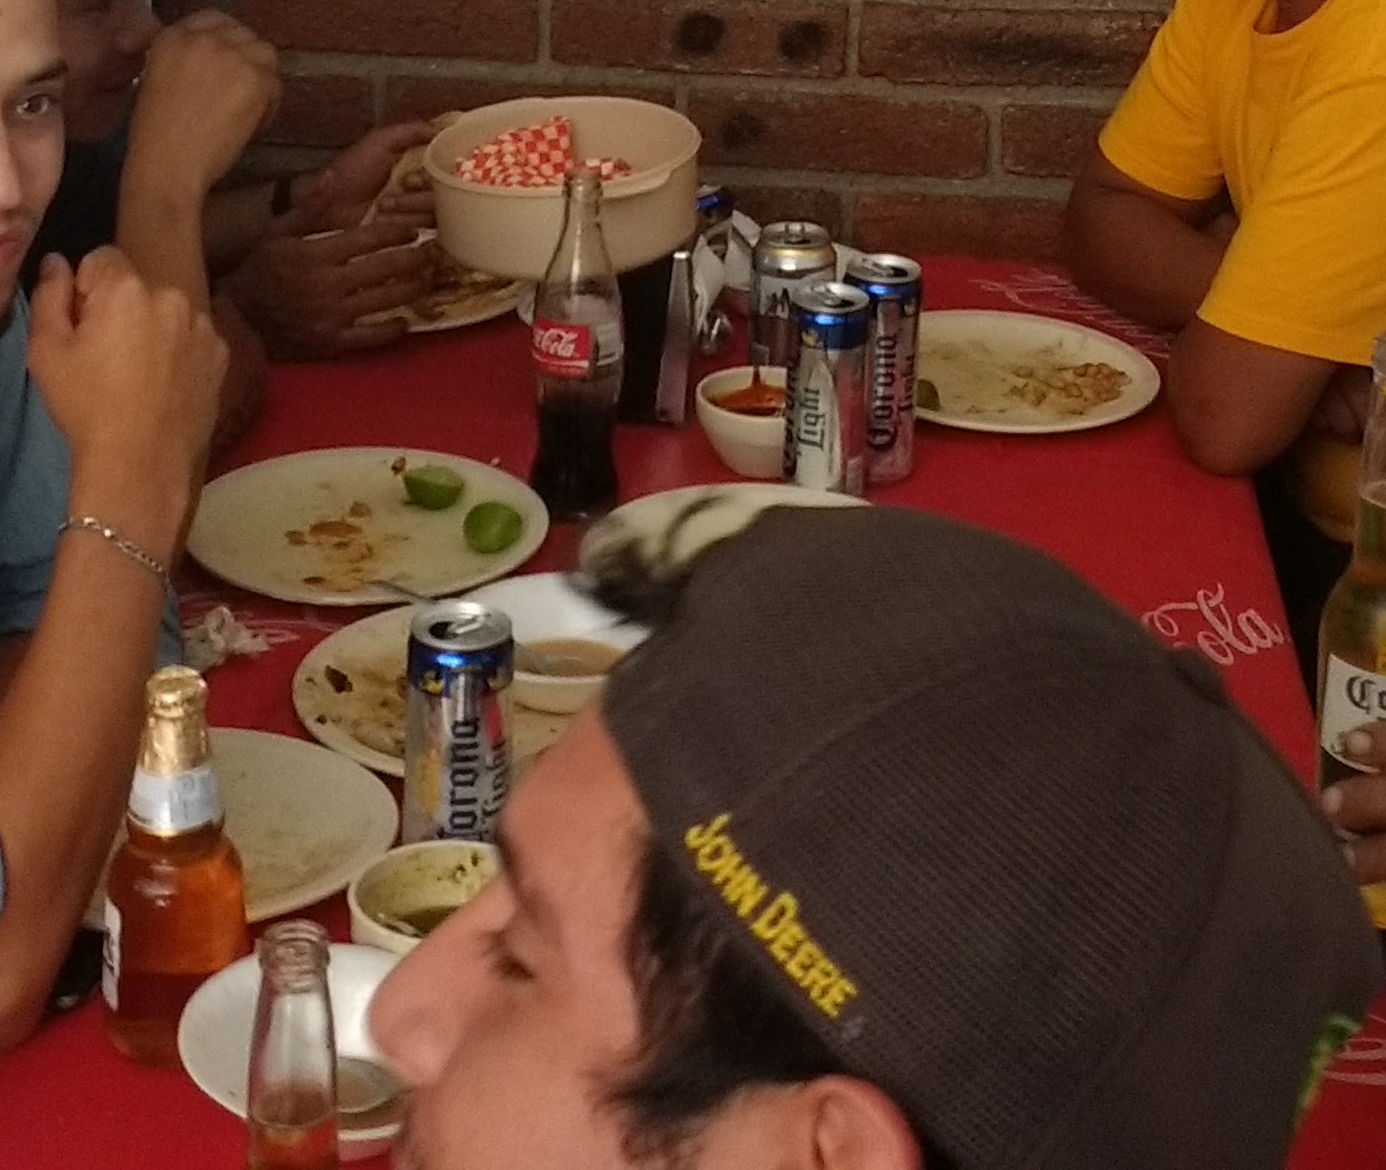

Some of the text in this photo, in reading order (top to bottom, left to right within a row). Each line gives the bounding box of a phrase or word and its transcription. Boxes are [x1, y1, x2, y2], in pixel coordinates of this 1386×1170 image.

[798, 387, 826, 451] Light
[684, 813, 859, 1019] JOHN DEERE
